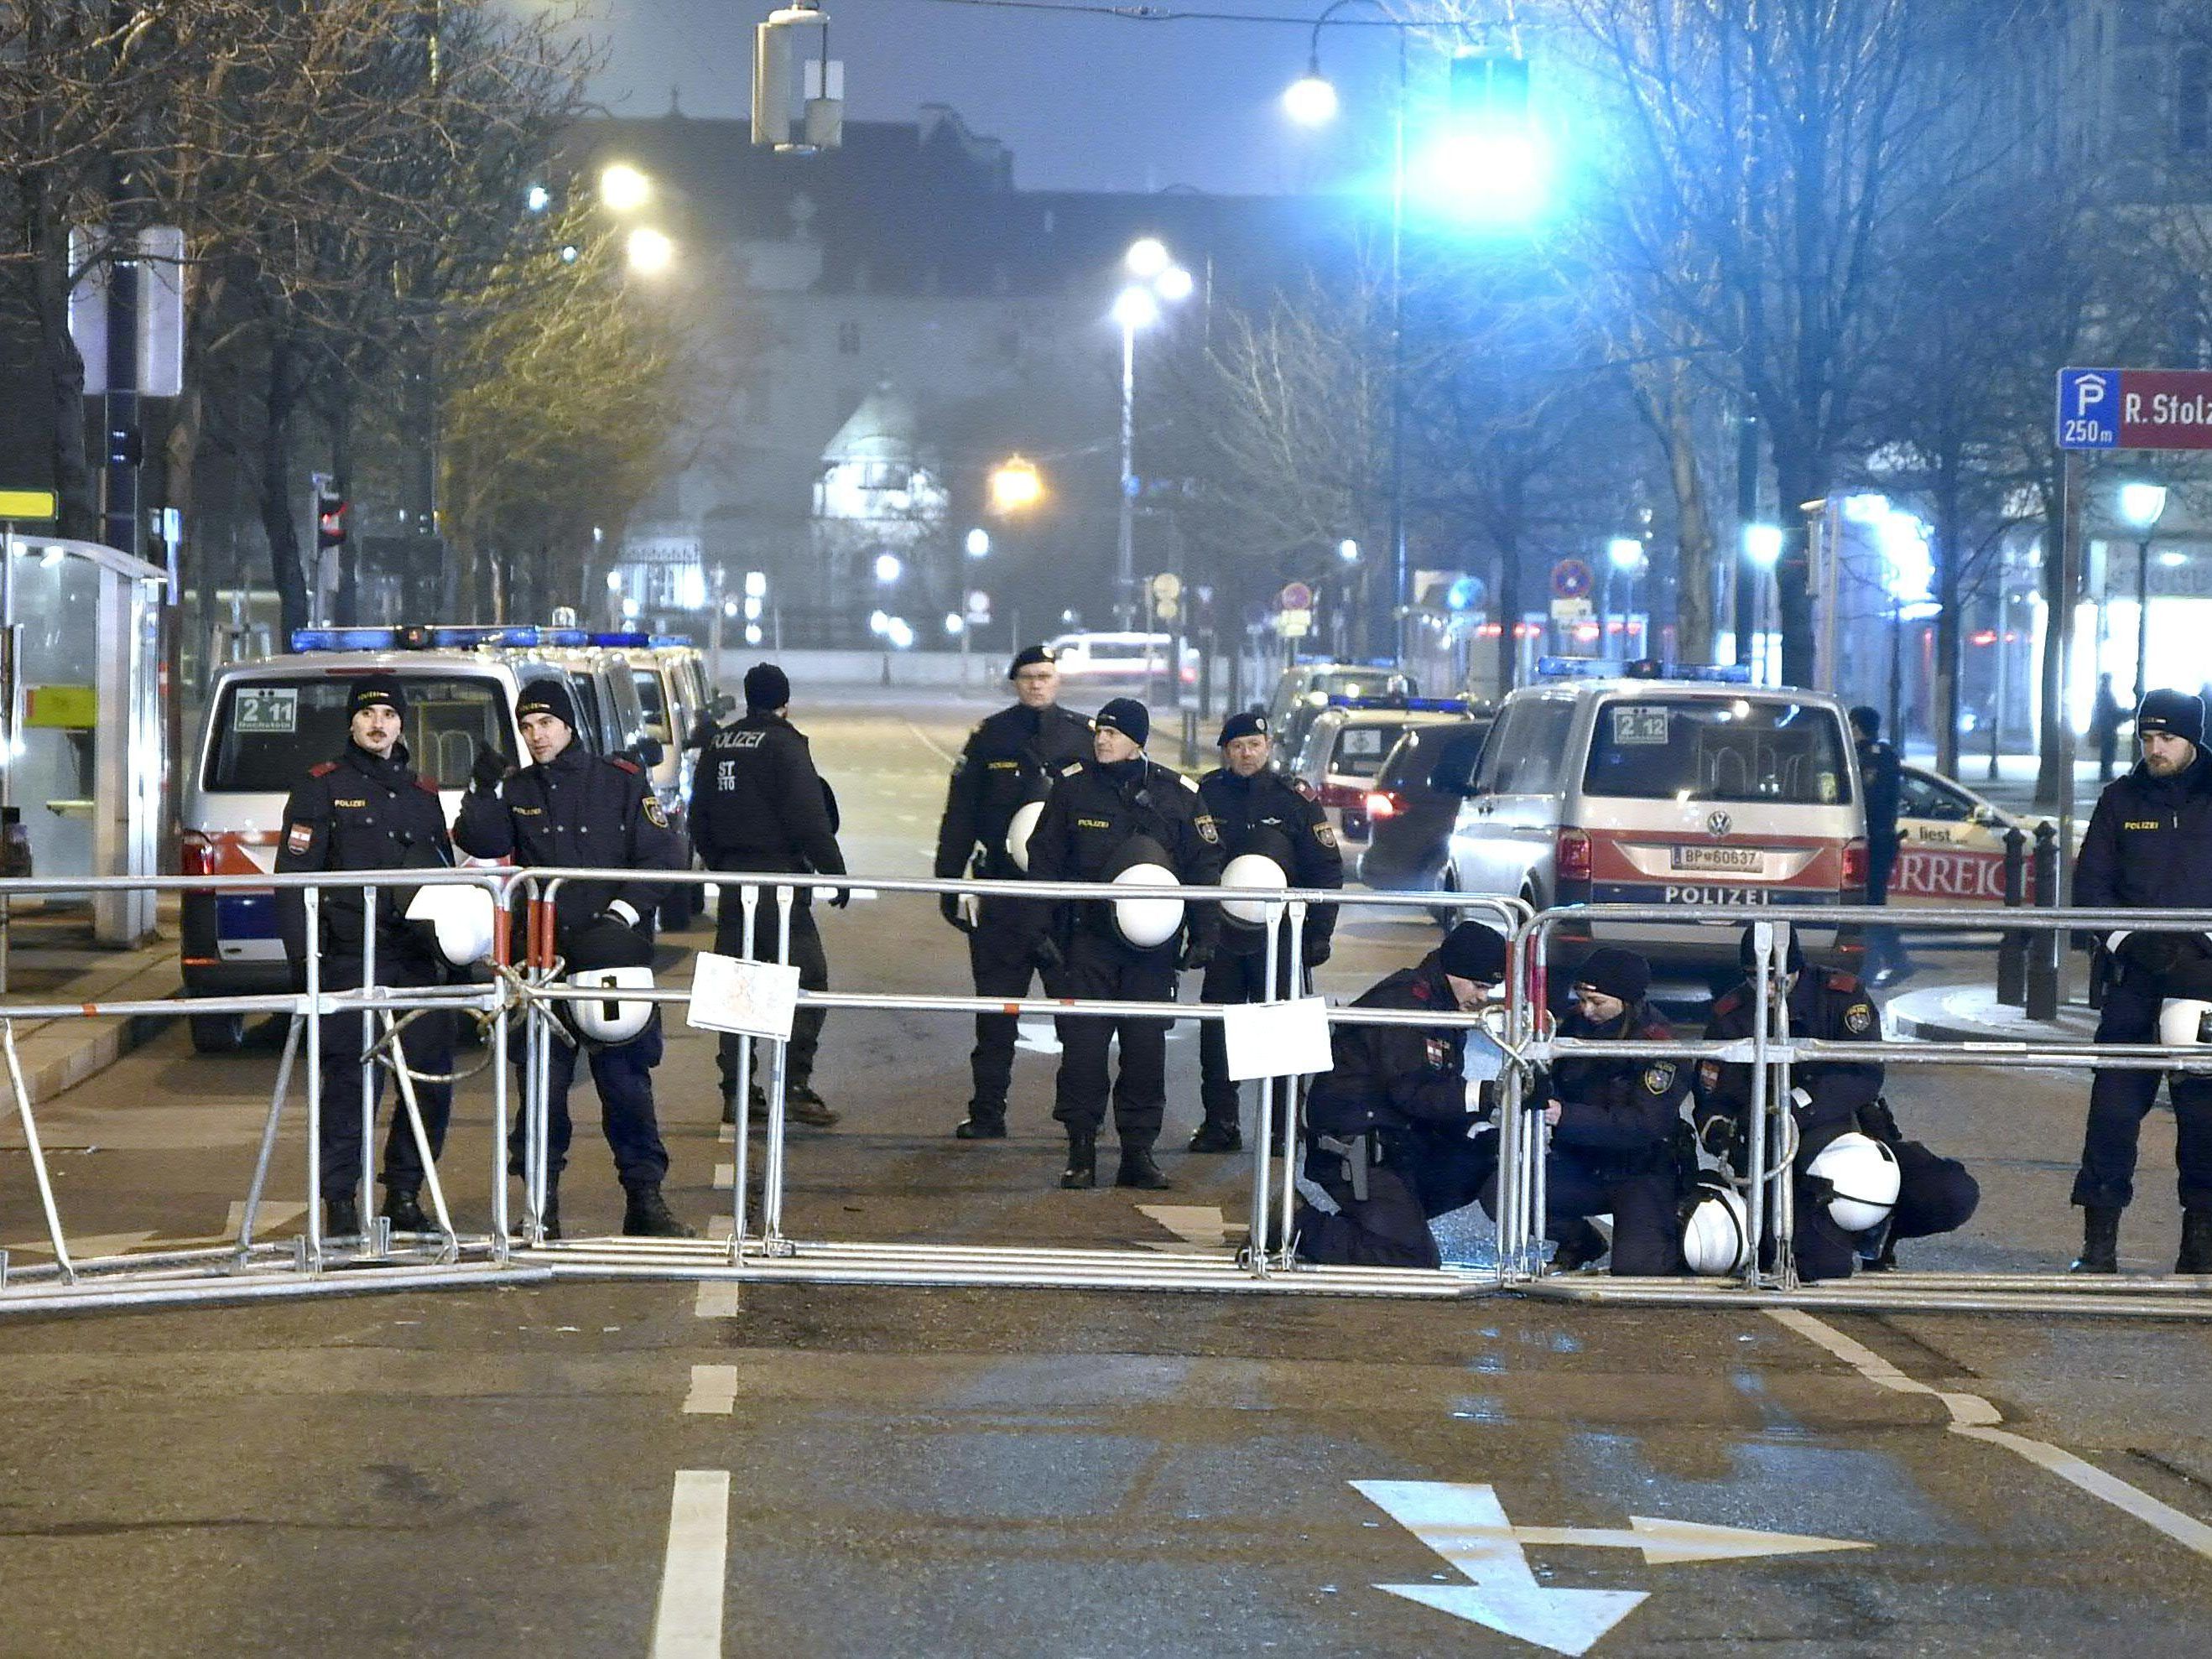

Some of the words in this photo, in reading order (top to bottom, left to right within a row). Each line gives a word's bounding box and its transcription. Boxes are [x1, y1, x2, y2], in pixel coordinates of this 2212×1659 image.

[718, 761, 735, 777] ST
[1887, 852, 2035, 899] RREIC
[1665, 886, 1769, 905] POLIZEI
